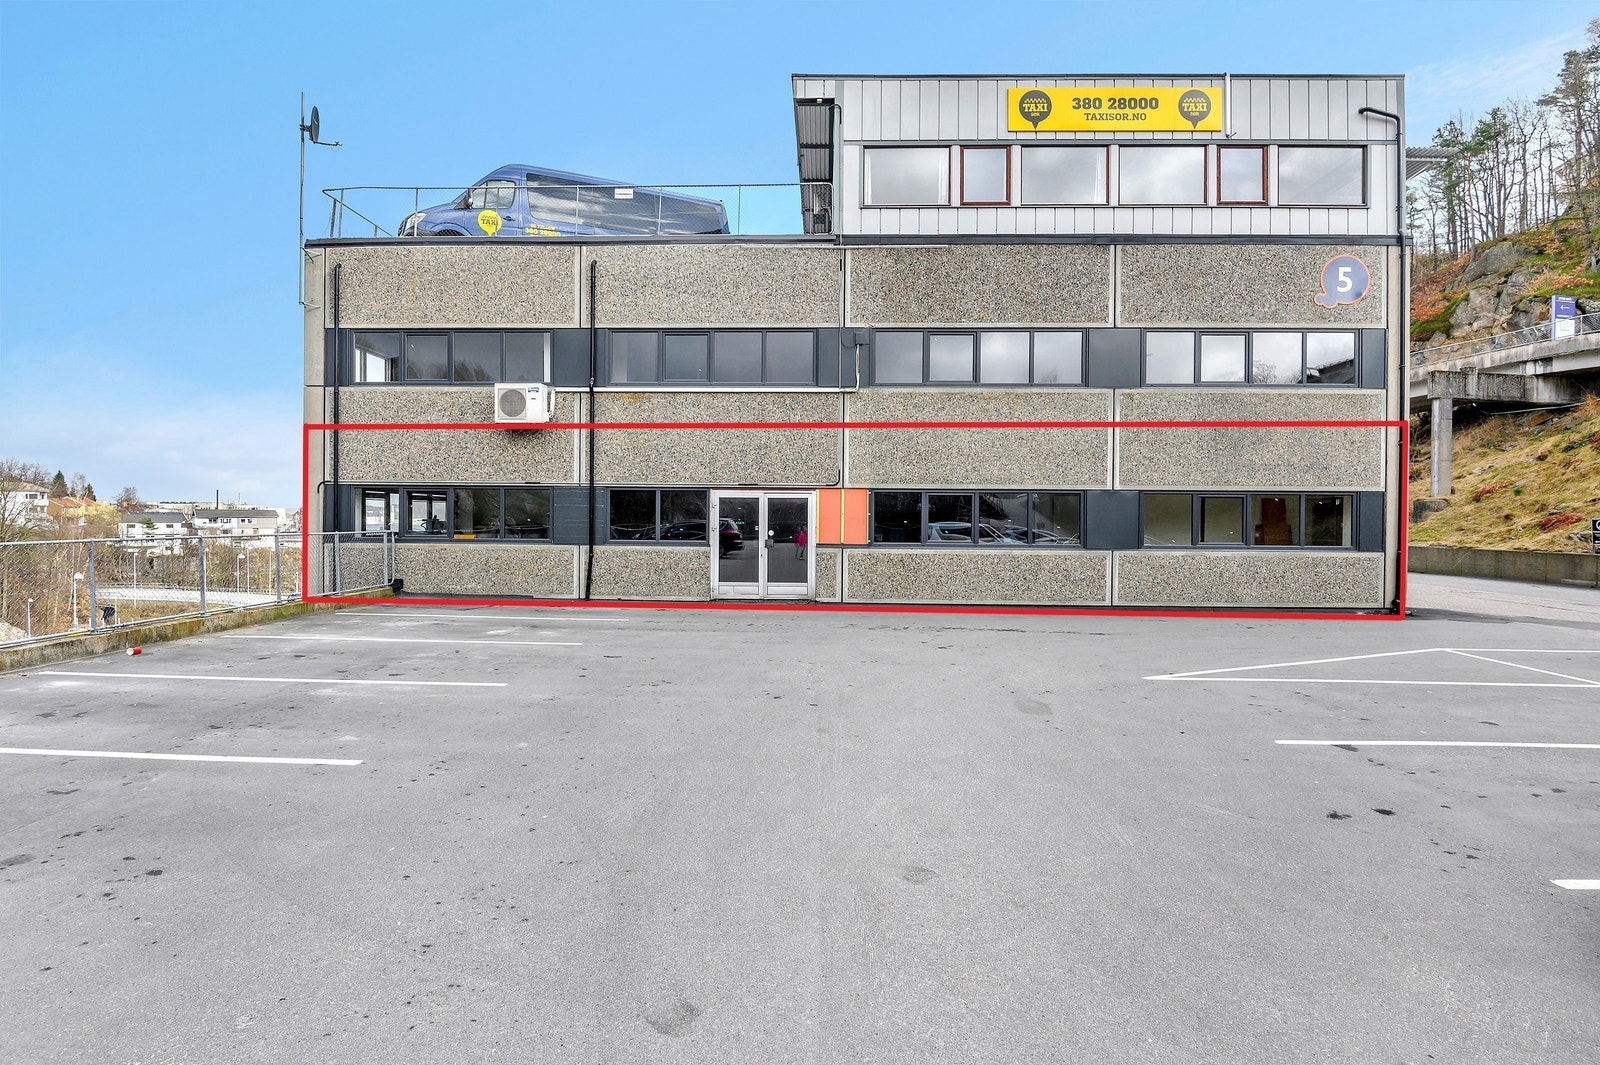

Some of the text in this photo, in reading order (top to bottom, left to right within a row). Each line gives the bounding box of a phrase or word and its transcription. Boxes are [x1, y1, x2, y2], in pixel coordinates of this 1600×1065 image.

[1022, 103, 1048, 112] TAXI
[1071, 97, 1159, 110] 380 28000
[1182, 102, 1208, 112] TAXI
[1084, 112, 1147, 121] TAXISOR.NO
[1336, 266, 1353, 293] 5
